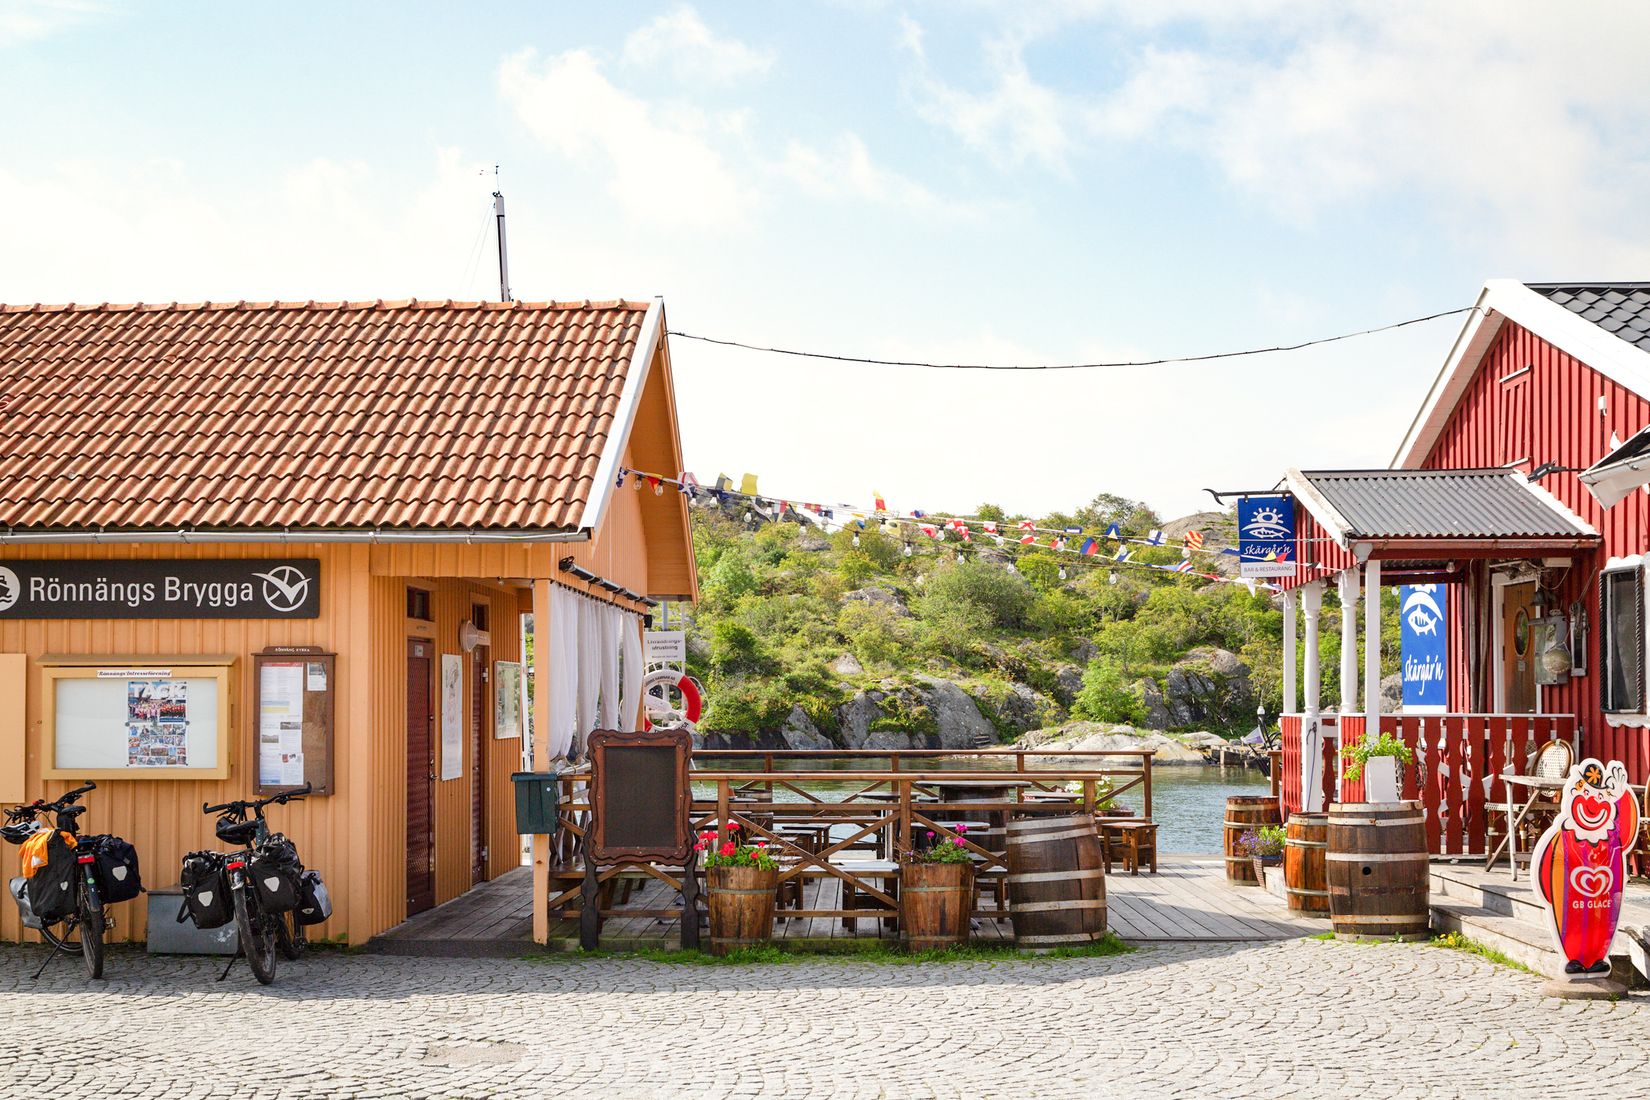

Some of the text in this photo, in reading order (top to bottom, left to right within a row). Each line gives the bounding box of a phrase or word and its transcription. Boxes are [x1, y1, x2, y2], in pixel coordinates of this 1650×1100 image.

[29, 576, 253, 607] Rönnängs Brygga
[1572, 899, 1611, 909] GB GLACE
